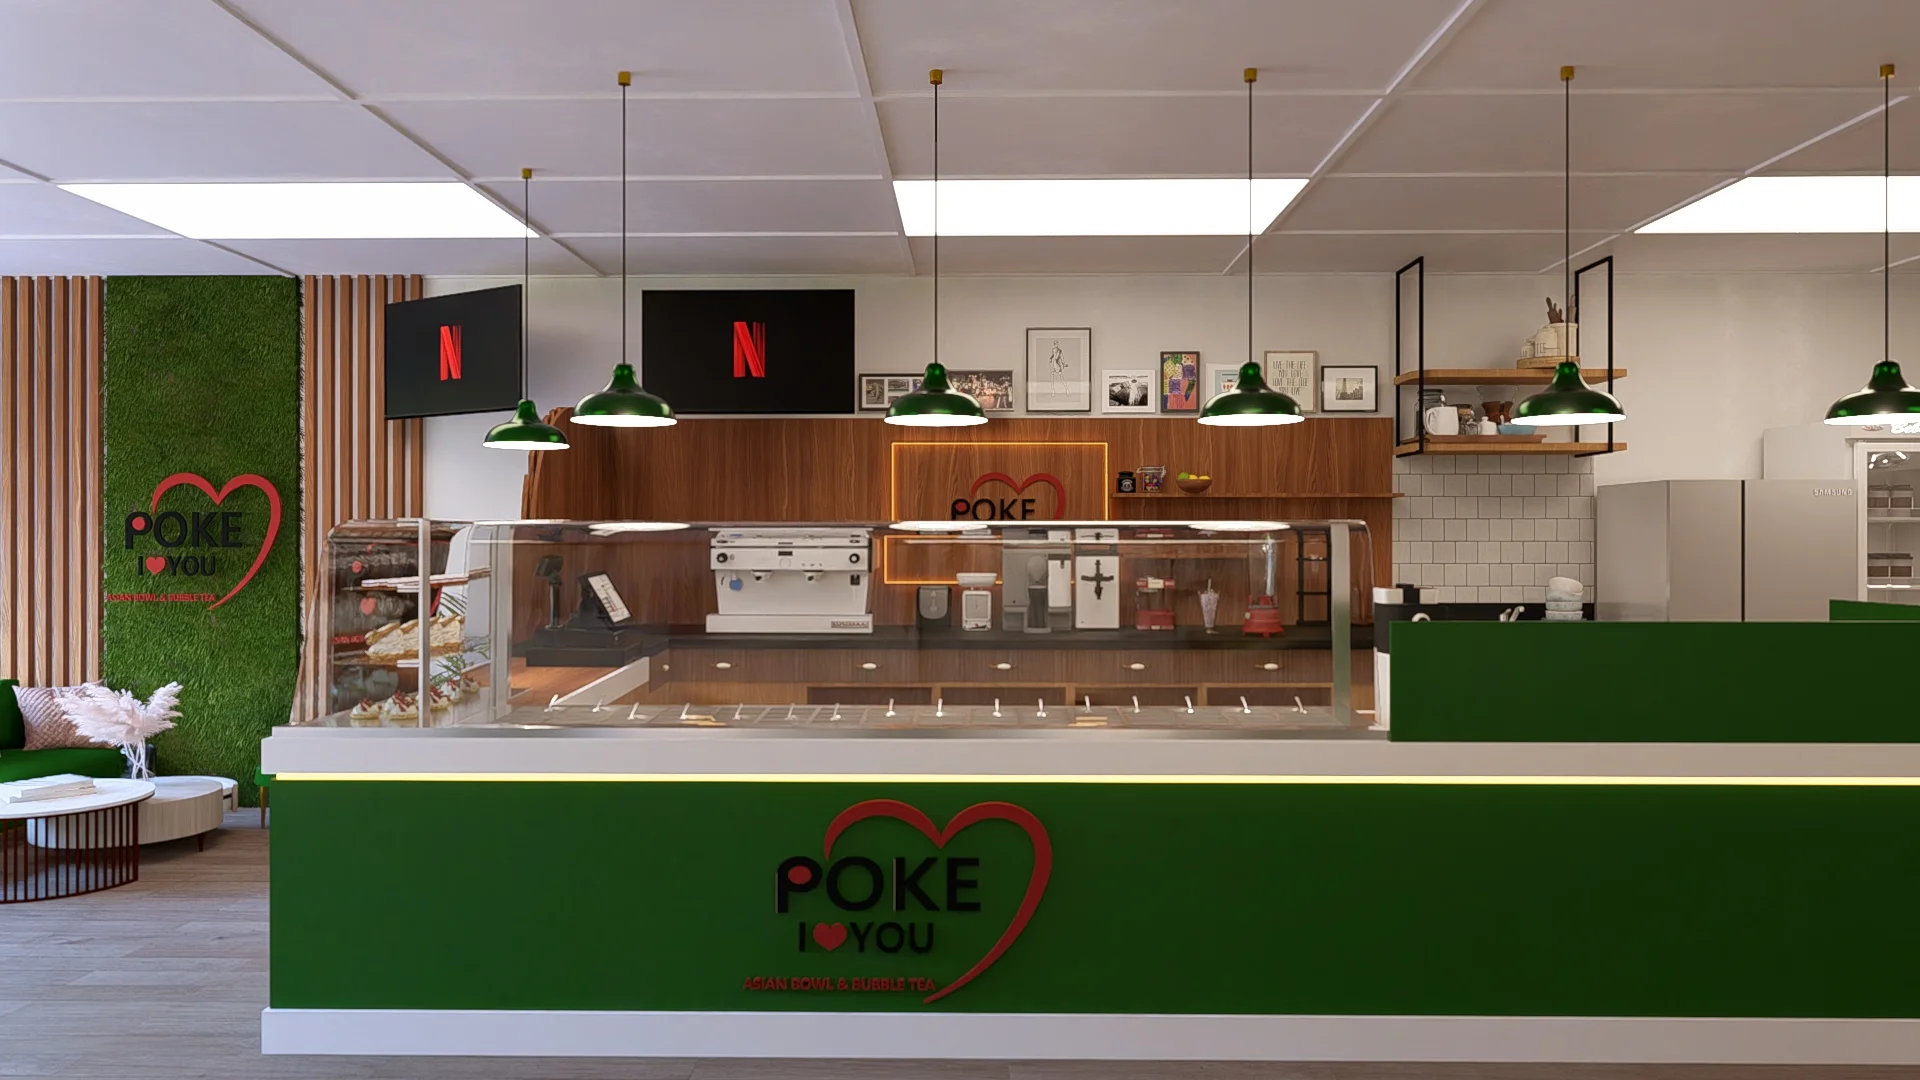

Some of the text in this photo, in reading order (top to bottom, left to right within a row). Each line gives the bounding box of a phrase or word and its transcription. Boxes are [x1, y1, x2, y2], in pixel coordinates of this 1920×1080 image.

[440, 325, 461, 381] N
[733, 321, 765, 378] N
[1813, 488, 1853, 497] SAMSUNG
[125, 511, 242, 549] POKE
[167, 555, 216, 577] YOU
[107, 593, 132, 602] ASIAN
[133, 593, 157, 602] BOWL
[168, 593, 198, 602] BUBBLE
[200, 593, 216, 602] TEA
[775, 856, 981, 914] POKE
[799, 921, 934, 954] I YOU
[743, 977, 936, 991] ASIAN BOWL & BUBBLE TEA
